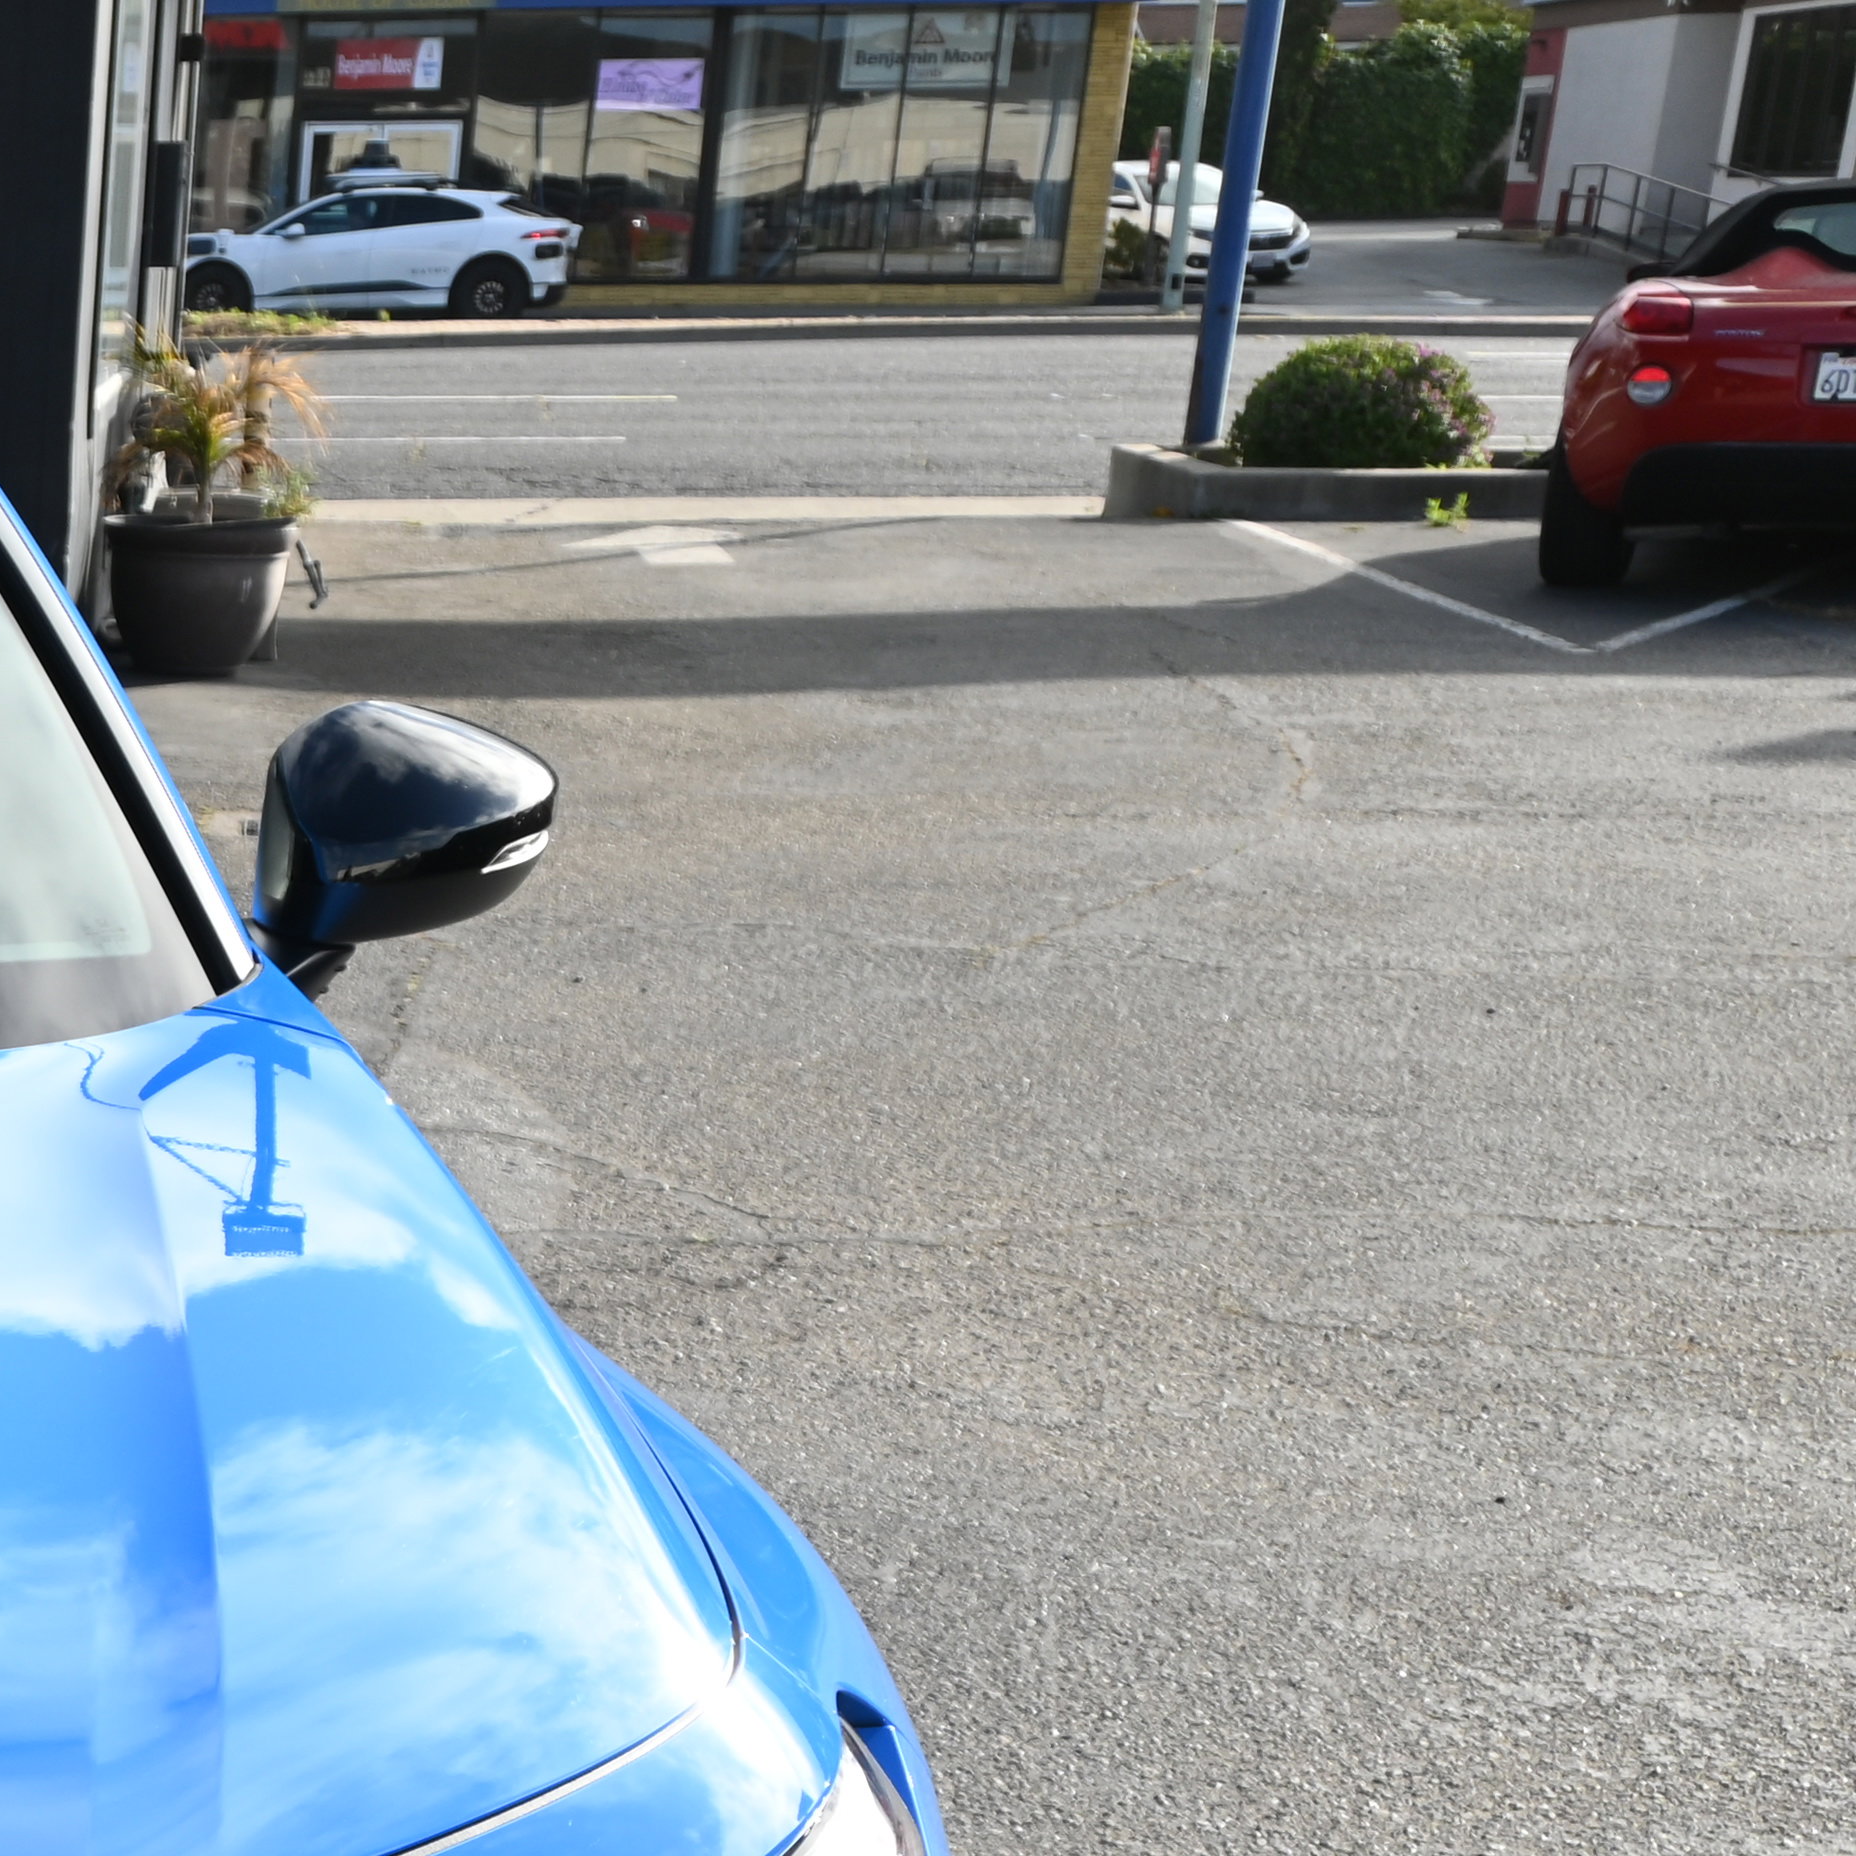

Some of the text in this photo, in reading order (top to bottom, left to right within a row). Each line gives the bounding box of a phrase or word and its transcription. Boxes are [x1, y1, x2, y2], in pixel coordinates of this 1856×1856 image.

[338, 53, 381, 80] Benjamin
[382, 53, 413, 74] Moore
[855, 48, 994, 68] Benjamin Moor
[1820, 368, 1856, 394] 6D
